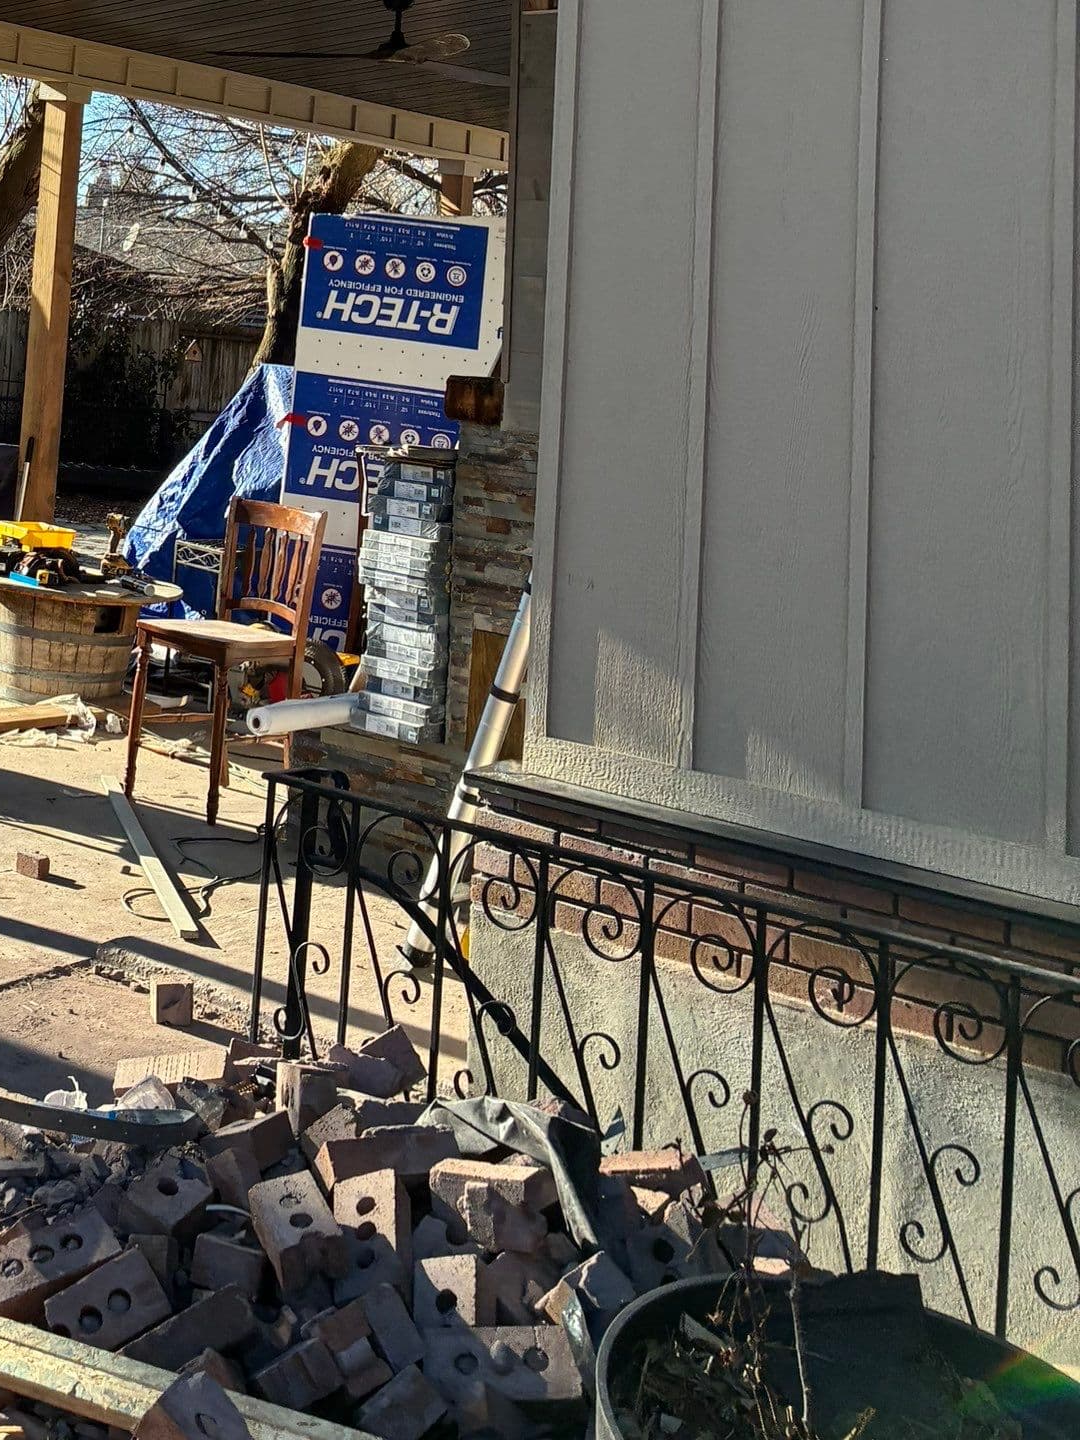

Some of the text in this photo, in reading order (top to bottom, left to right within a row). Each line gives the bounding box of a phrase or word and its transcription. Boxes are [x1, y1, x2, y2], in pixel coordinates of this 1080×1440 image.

[328, 278, 465, 303] ENGINEERED FOR EFFICIENCY
